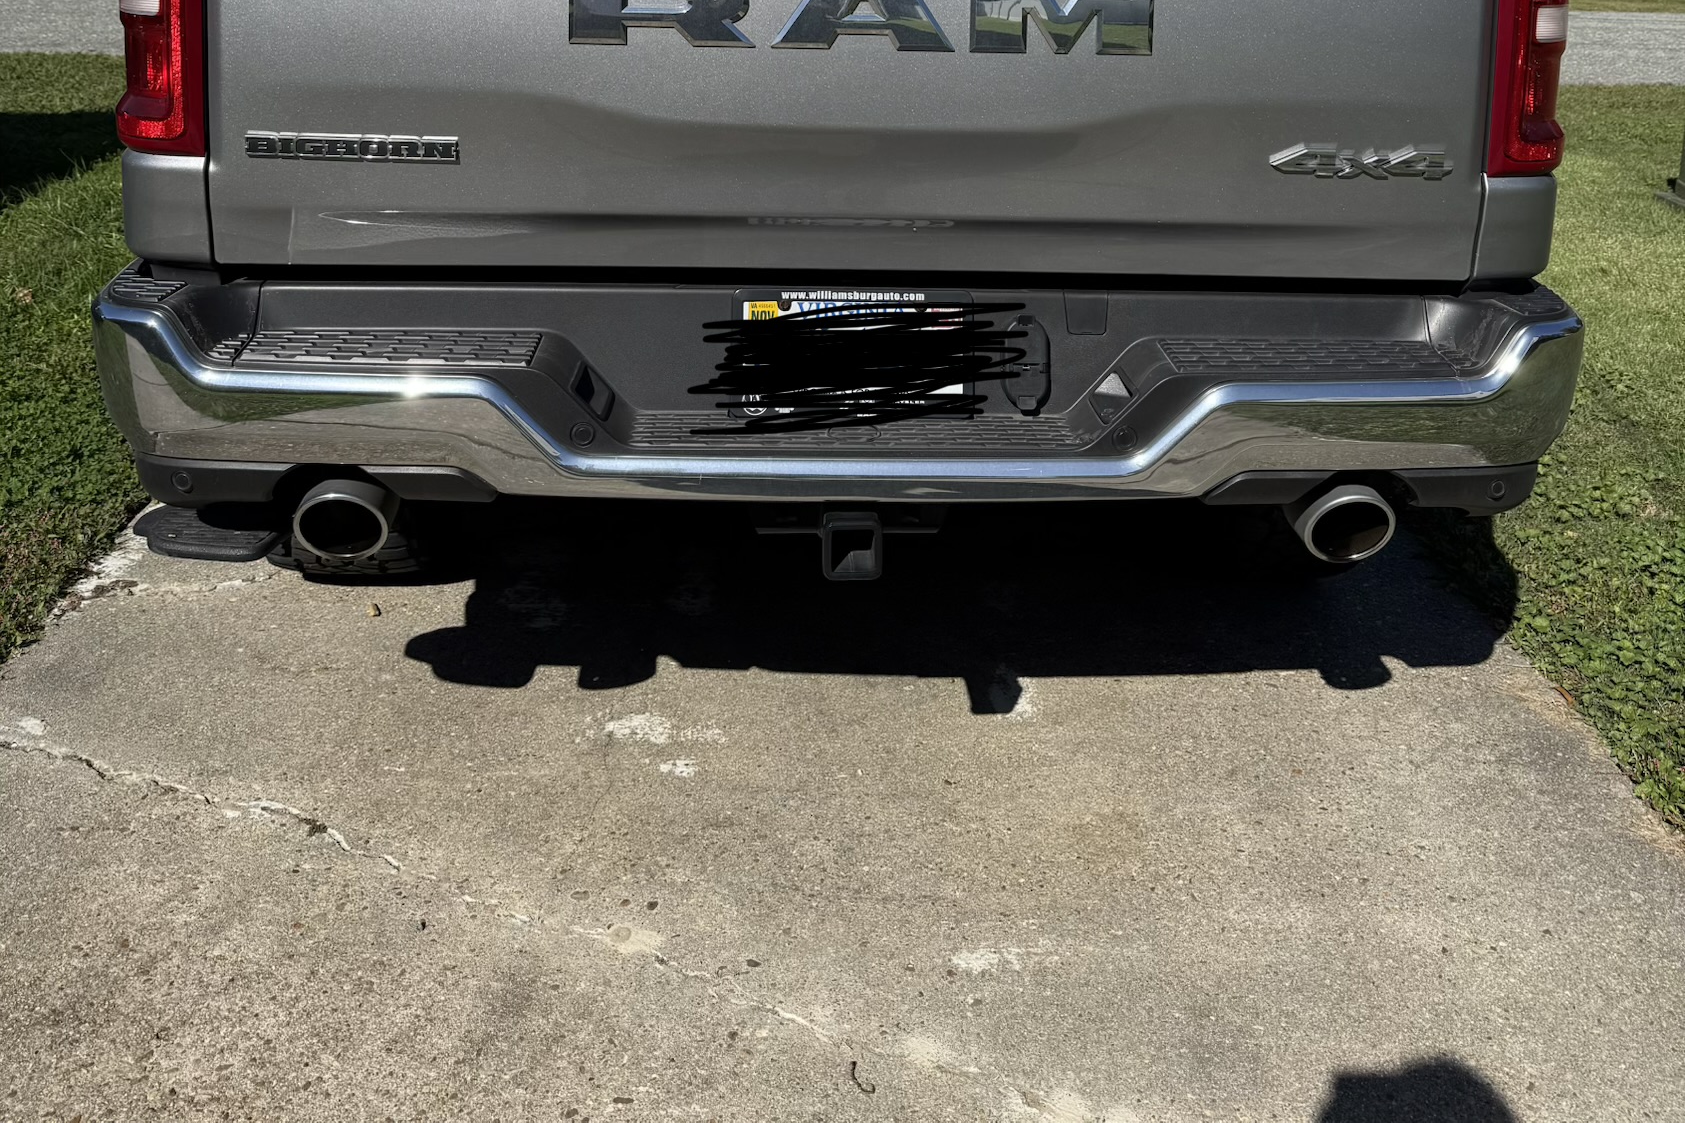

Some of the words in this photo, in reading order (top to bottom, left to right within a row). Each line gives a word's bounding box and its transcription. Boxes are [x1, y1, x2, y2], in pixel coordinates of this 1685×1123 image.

[245, 129, 459, 161] BIGHORN
[781, 290, 925, 301] www.williamsburgauto.com
[751, 310, 775, 320] NOV
